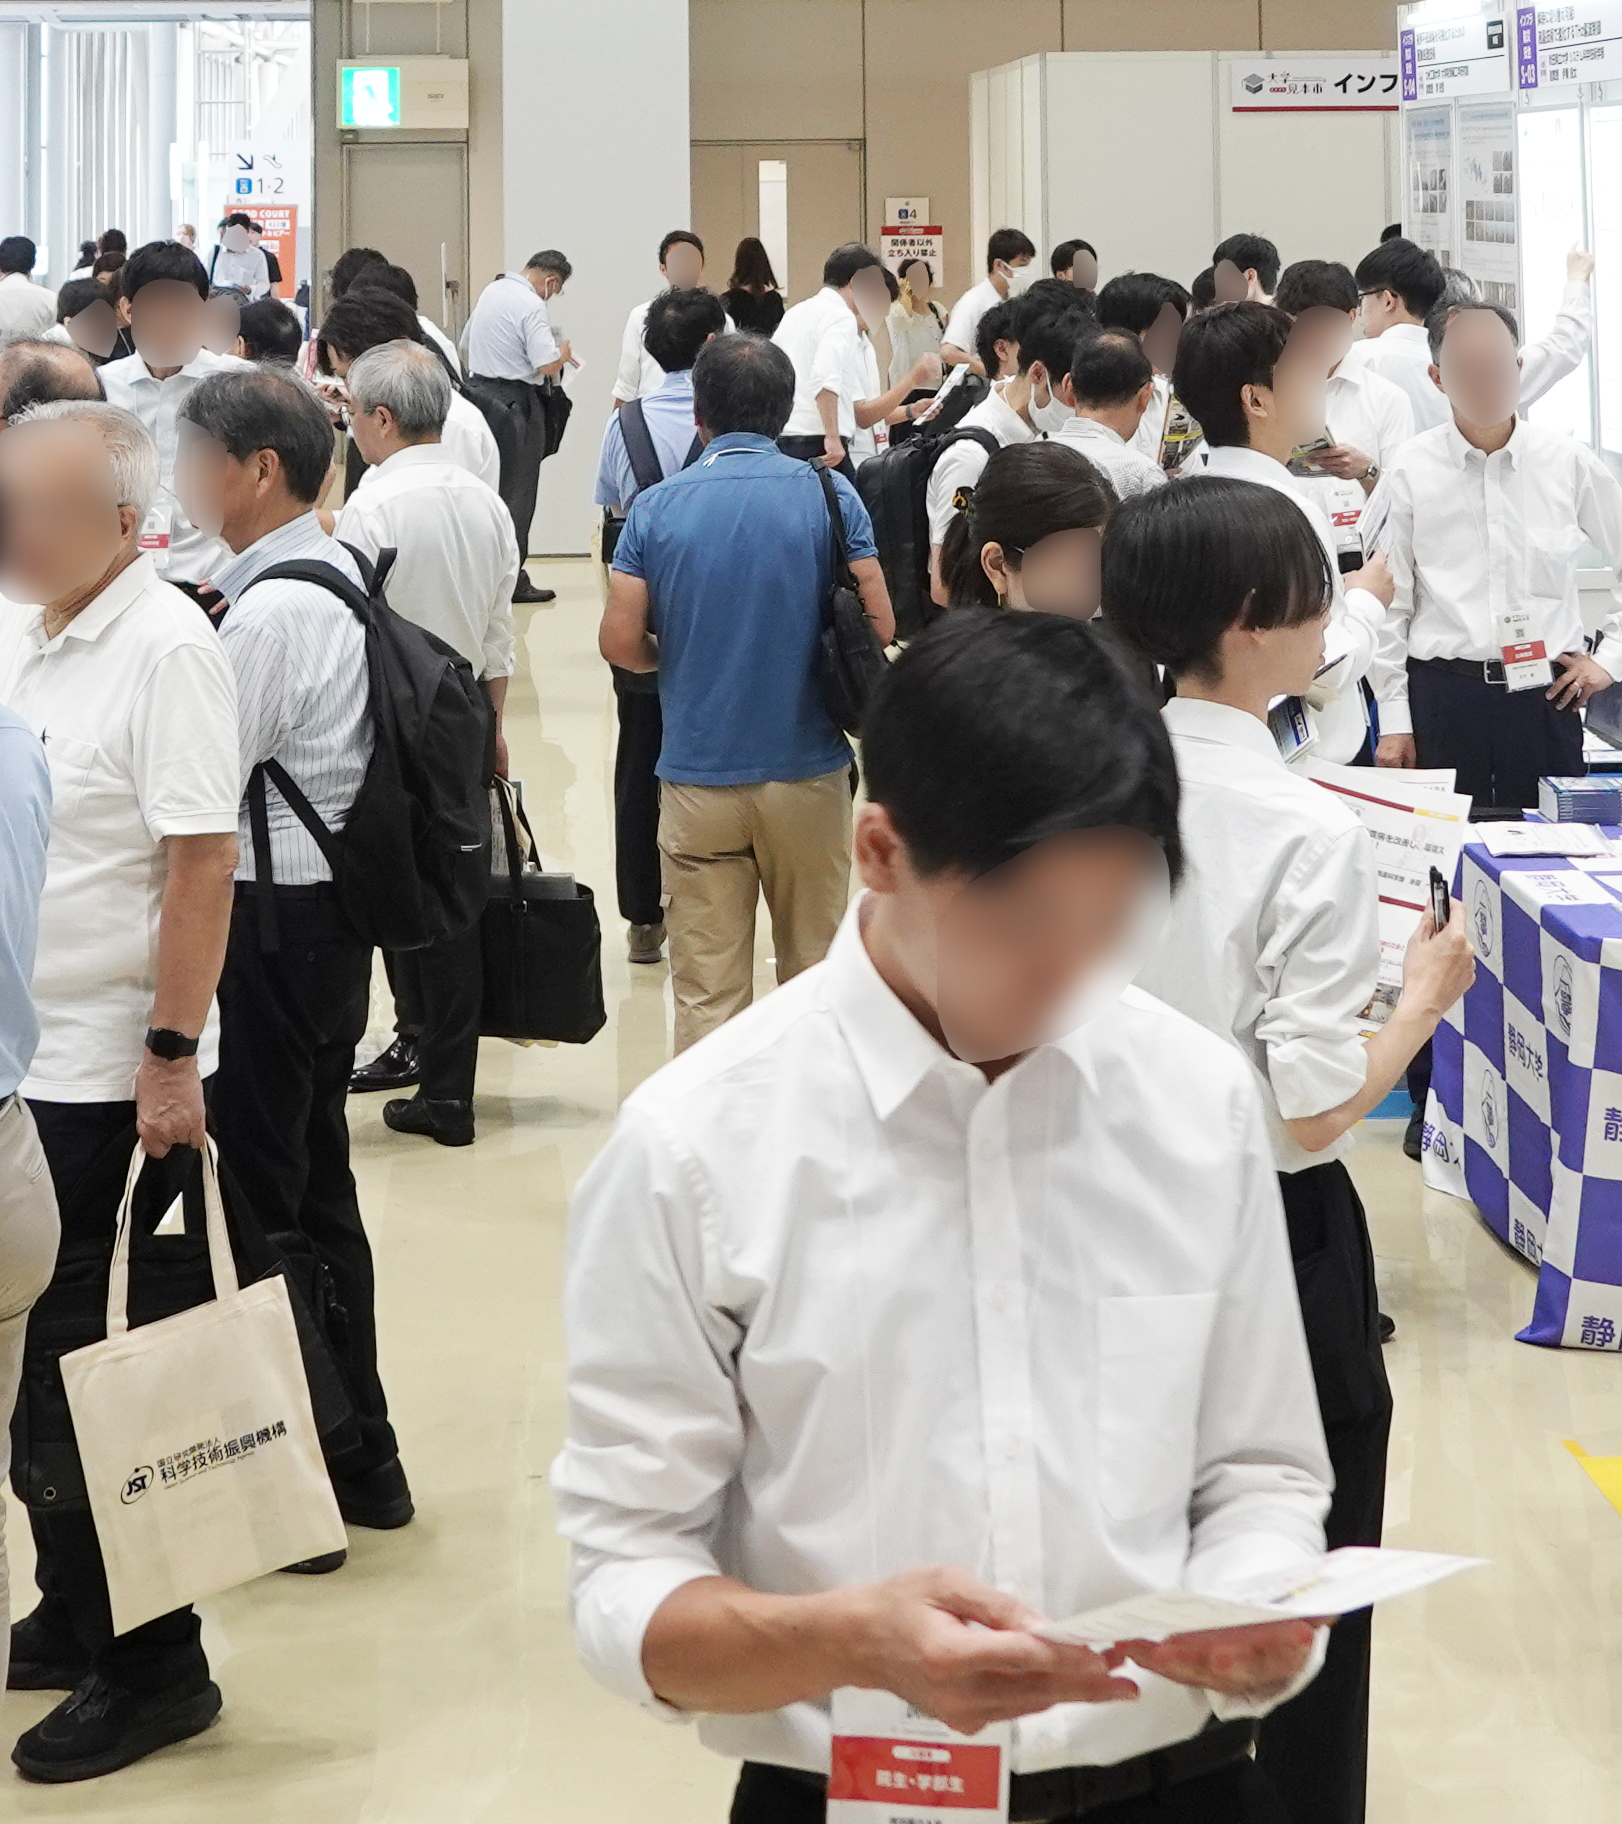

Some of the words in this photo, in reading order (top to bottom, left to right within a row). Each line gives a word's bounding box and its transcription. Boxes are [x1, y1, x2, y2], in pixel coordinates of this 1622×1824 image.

[909, 209, 917, 219] 4
[160, 1420, 287, 1483] 科学技術振興機構
[126, 1475, 148, 1497] JST
